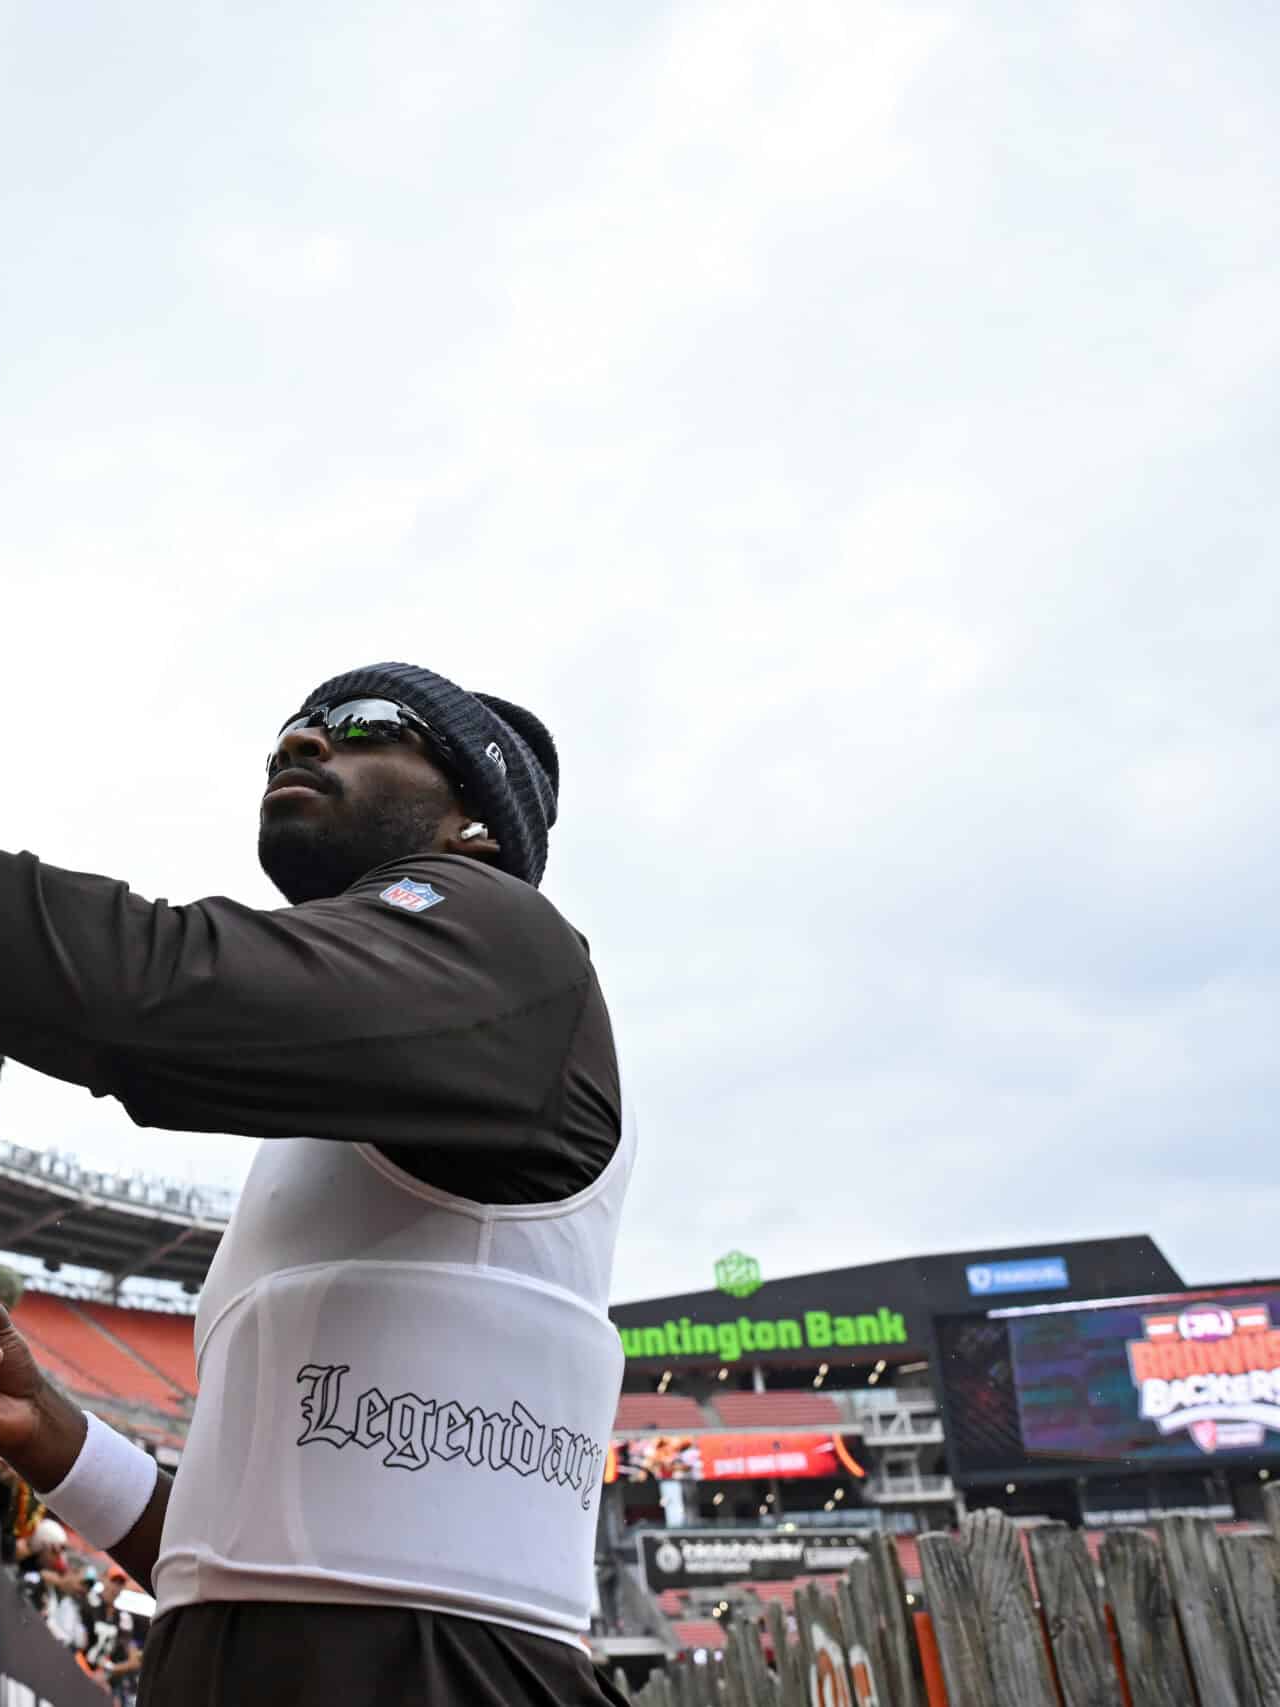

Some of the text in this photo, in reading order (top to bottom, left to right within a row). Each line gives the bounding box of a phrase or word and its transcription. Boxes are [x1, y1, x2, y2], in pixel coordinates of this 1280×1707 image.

[620, 1307, 907, 1361] untington Bank
[296, 1364, 602, 1510] Legendary
